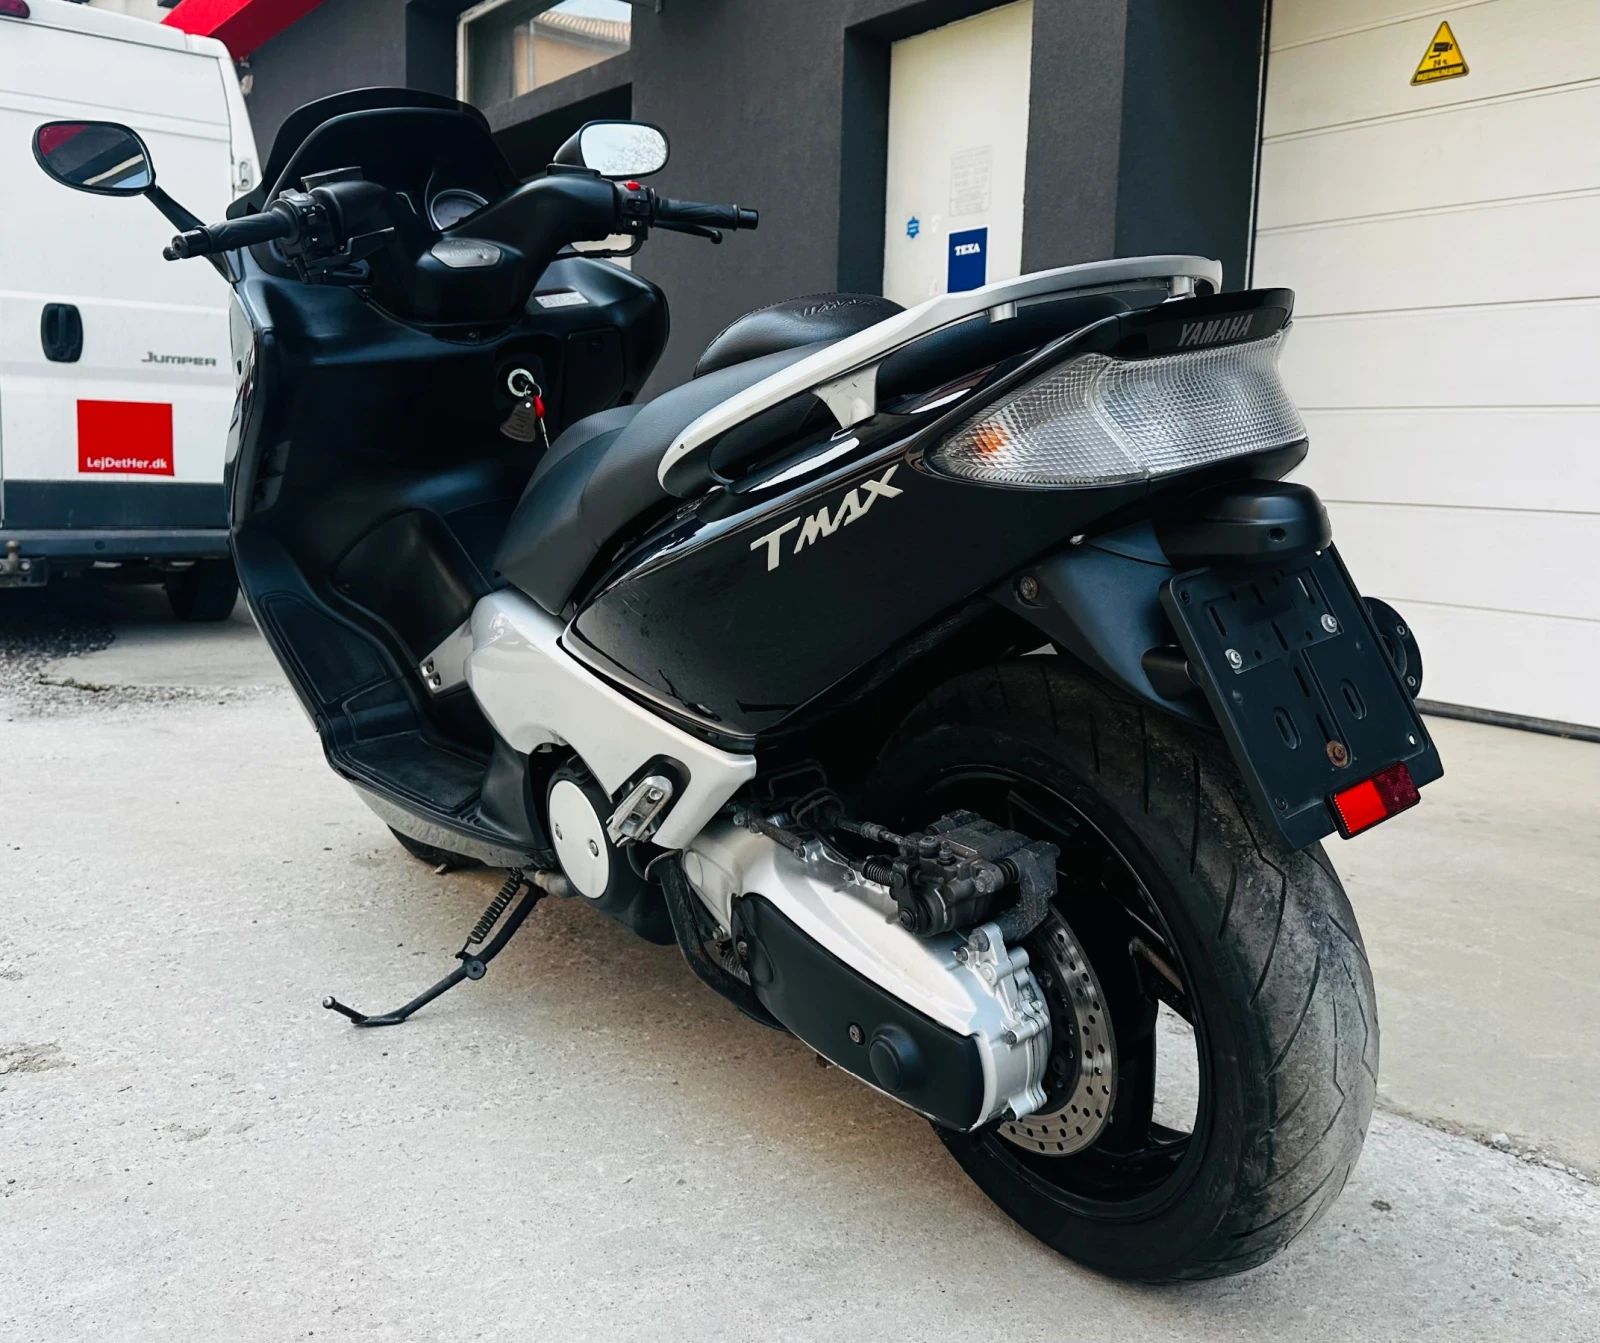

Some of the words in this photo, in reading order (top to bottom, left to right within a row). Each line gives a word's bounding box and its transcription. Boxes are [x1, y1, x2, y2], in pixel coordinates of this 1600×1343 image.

[954, 243, 981, 256] TEXA
[1177, 314, 1253, 347] YAMAHA
[86, 456, 168, 470] LejDetHer.dk
[750, 463, 904, 572] TMAX
